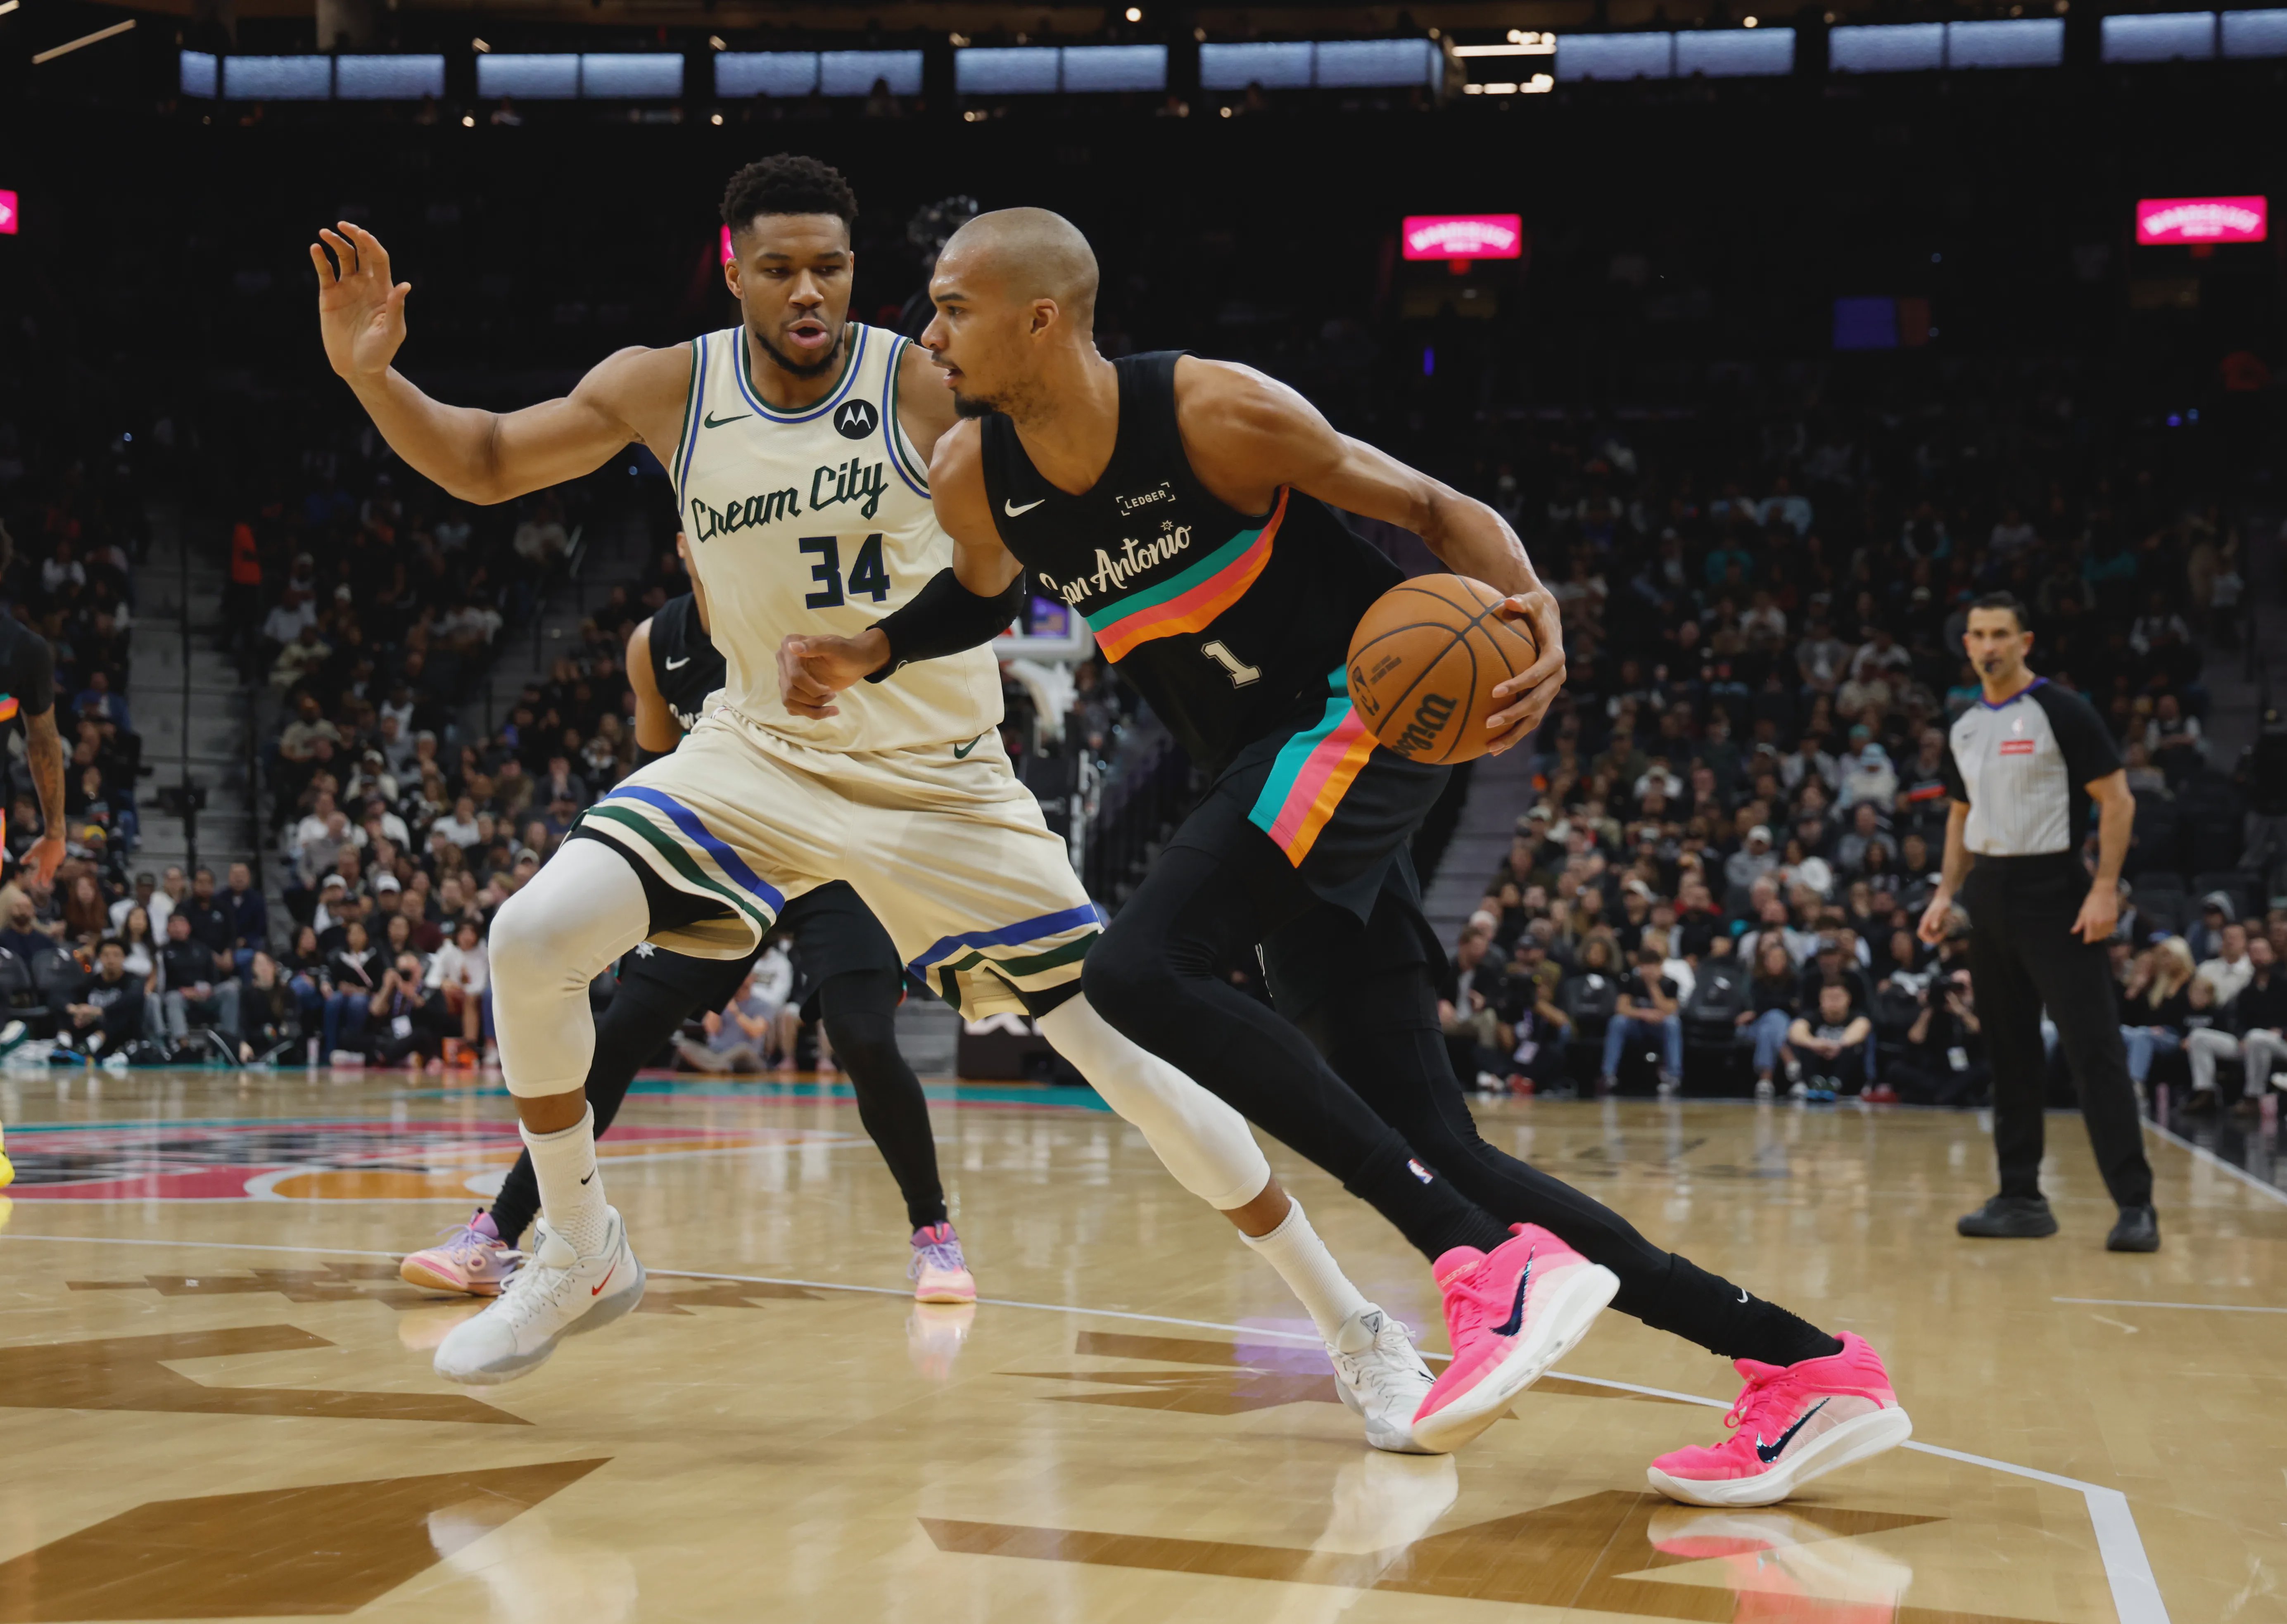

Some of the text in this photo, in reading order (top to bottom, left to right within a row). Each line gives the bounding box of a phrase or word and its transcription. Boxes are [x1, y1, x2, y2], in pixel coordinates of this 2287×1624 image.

[691, 457, 889, 543] Cream City
[1124, 490, 1166, 509] LEDGER
[798, 533, 891, 610] 34
[1090, 520, 1192, 592] Antonio
[1201, 640, 1262, 689] 1
